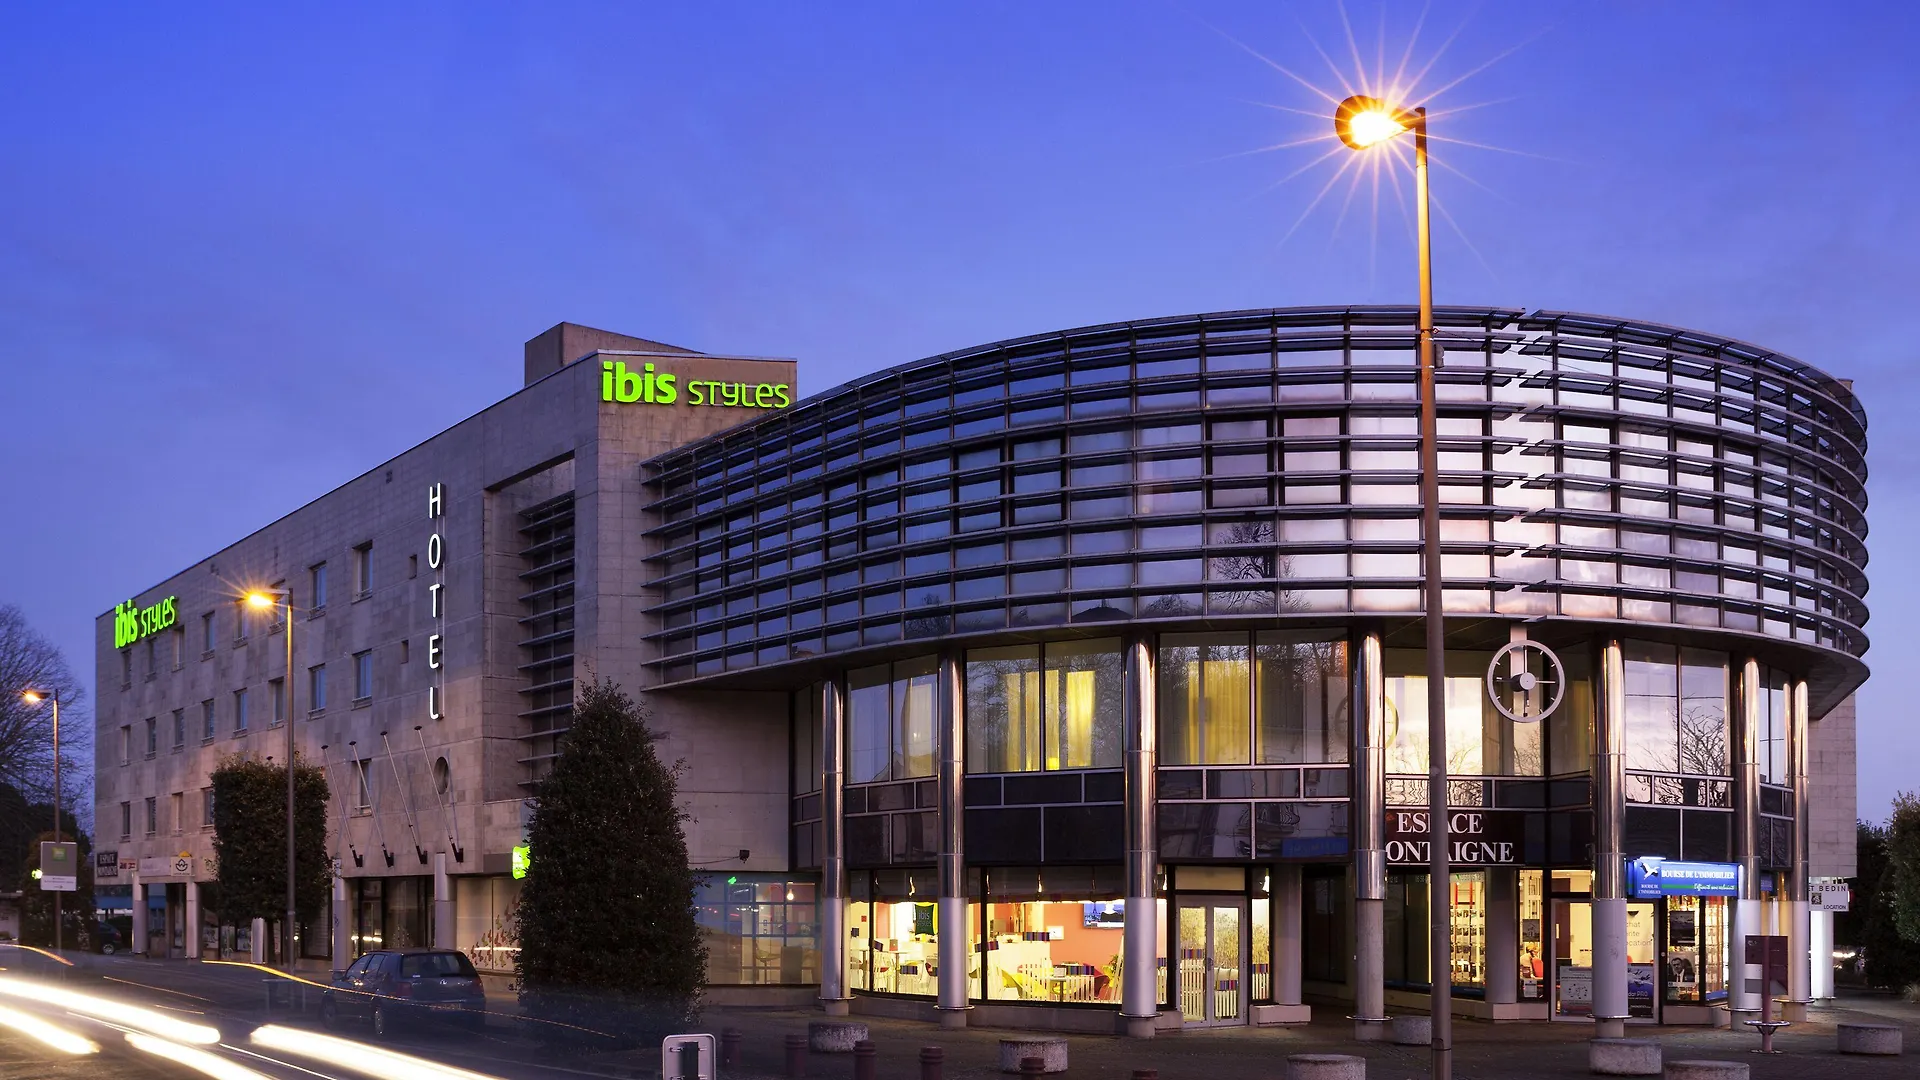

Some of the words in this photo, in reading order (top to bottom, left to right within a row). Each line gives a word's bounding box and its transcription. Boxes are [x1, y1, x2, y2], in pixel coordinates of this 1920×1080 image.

[602, 361, 677, 404] ibis
[428, 482, 441, 720] HOTEL
[115, 599, 138, 649] ibis
[1396, 812, 1484, 834] ESCE
[1385, 840, 1515, 863] ONTIGNE
[1661, 869, 1685, 879] BOURSE
[1685, 870, 1694, 879] DE
[1695, 870, 1735, 880] L'IMMOBILIER
[918, 910, 930, 920] ibis
